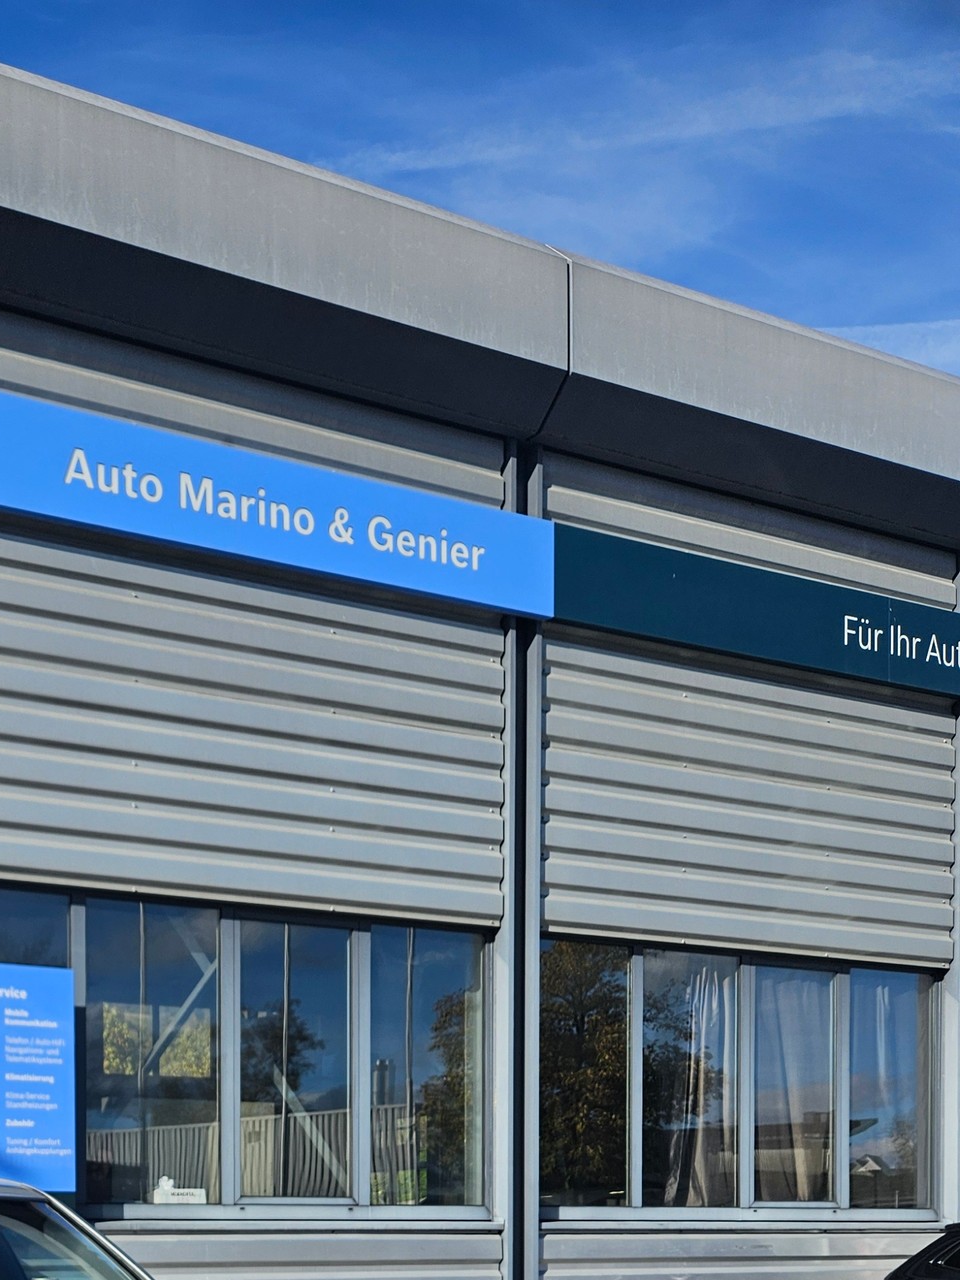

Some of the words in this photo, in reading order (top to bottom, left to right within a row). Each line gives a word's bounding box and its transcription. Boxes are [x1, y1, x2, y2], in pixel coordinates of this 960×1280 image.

[64, 446, 163, 503] Auto
[178, 470, 315, 536] Marino
[328, 506, 355, 545] &
[367, 514, 486, 572] Genier
[844, 615, 884, 652] Für
[890, 624, 922, 660] Ihr
